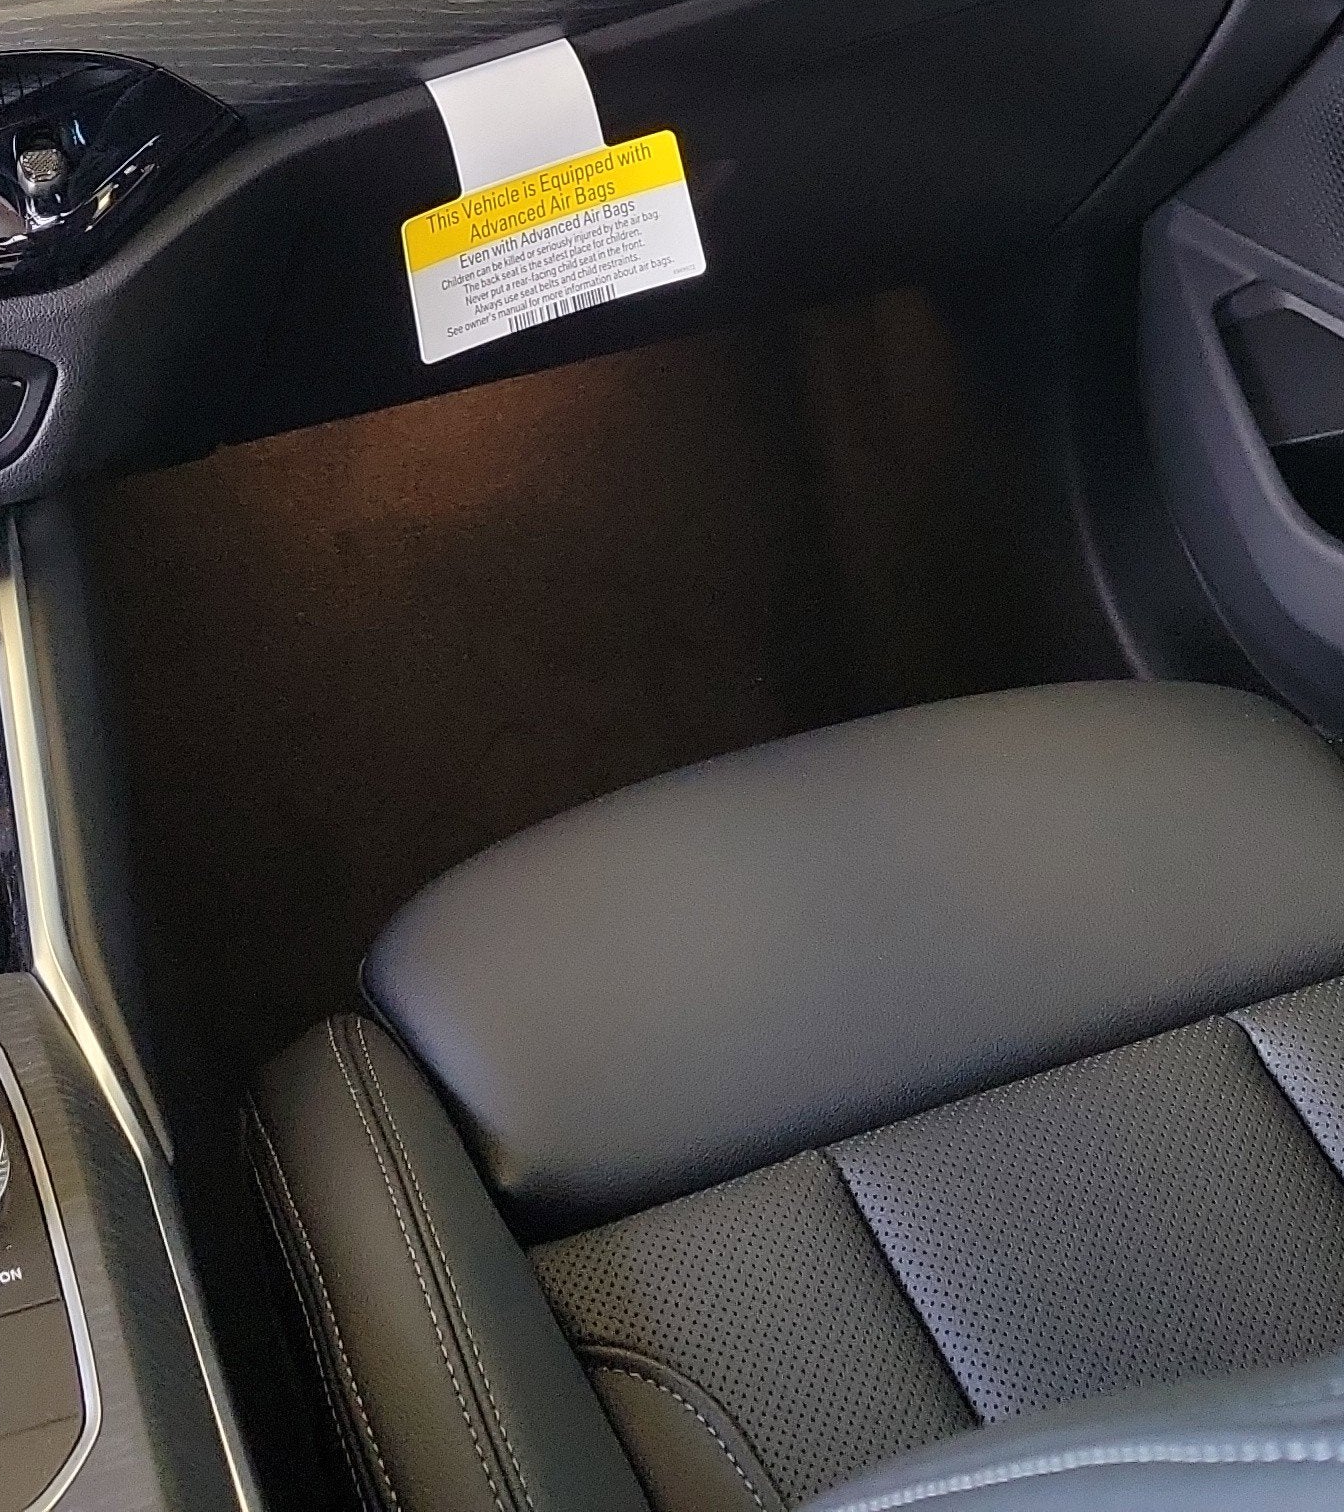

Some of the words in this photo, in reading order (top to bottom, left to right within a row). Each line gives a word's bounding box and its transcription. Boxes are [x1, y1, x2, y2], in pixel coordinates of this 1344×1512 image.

[425, 208, 461, 234] This
[461, 188, 521, 222] Vehicle
[522, 180, 537, 199] is
[539, 151, 615, 193] Equipped
[617, 142, 653, 167] with
[469, 201, 547, 244] Advanced
[550, 192, 571, 215] Air
[574, 180, 617, 206] Bags
[441, 270, 476, 291] Children
[476, 265, 492, 278] can
[492, 260, 503, 272] be
[503, 252, 526, 267] killed
[527, 249, 537, 260] or
[537, 233, 575, 256] seriously
[574, 226, 603, 245] injured
[603, 222, 614, 235] by
[615, 217, 629, 230] the
[630, 213, 641, 225] air
[642, 209, 659, 222] bag
[459, 249, 491, 269] Even
[492, 237, 519, 257] with
[520, 213, 582, 248] Advanced
[583, 208, 601, 227] Air
[602, 200, 636, 220] Bags
[463, 281, 481, 295] The
[481, 274, 502, 288] back
[502, 267, 520, 281] seat
[520, 263, 529, 274] is
[529, 259, 543, 271] the
[543, 249, 569, 267] safest
[569, 242, 592, 260] place
[592, 237, 605, 249] for
[606, 227, 643, 246] children.
[446, 323, 464, 338] See
[464, 312, 497, 332] owner's
[497, 298, 528, 319] manual
[528, 294, 541, 308] for
[541, 288, 564, 303] more
[564, 272, 613, 295] information
[612, 264, 639, 281] about
[638, 261, 650, 273] air
[650, 254, 676, 270] bags.
[465, 291, 490, 307] Never
[491, 286, 506, 300] put
[512, 266, 558, 289] rear-facing
[558, 257, 578, 274] child
[579, 252, 597, 267] seat
[597, 249, 607, 260] in
[607, 244, 622, 258] the
[622, 237, 646, 252] front.
[474, 297, 504, 316] Always
[504, 292, 519, 305] use
[520, 285, 539, 299] seat
[539, 277, 560, 294] belts
[560, 269, 577, 284] and
[577, 263, 597, 280] child
[598, 252, 641, 273] restraints.
